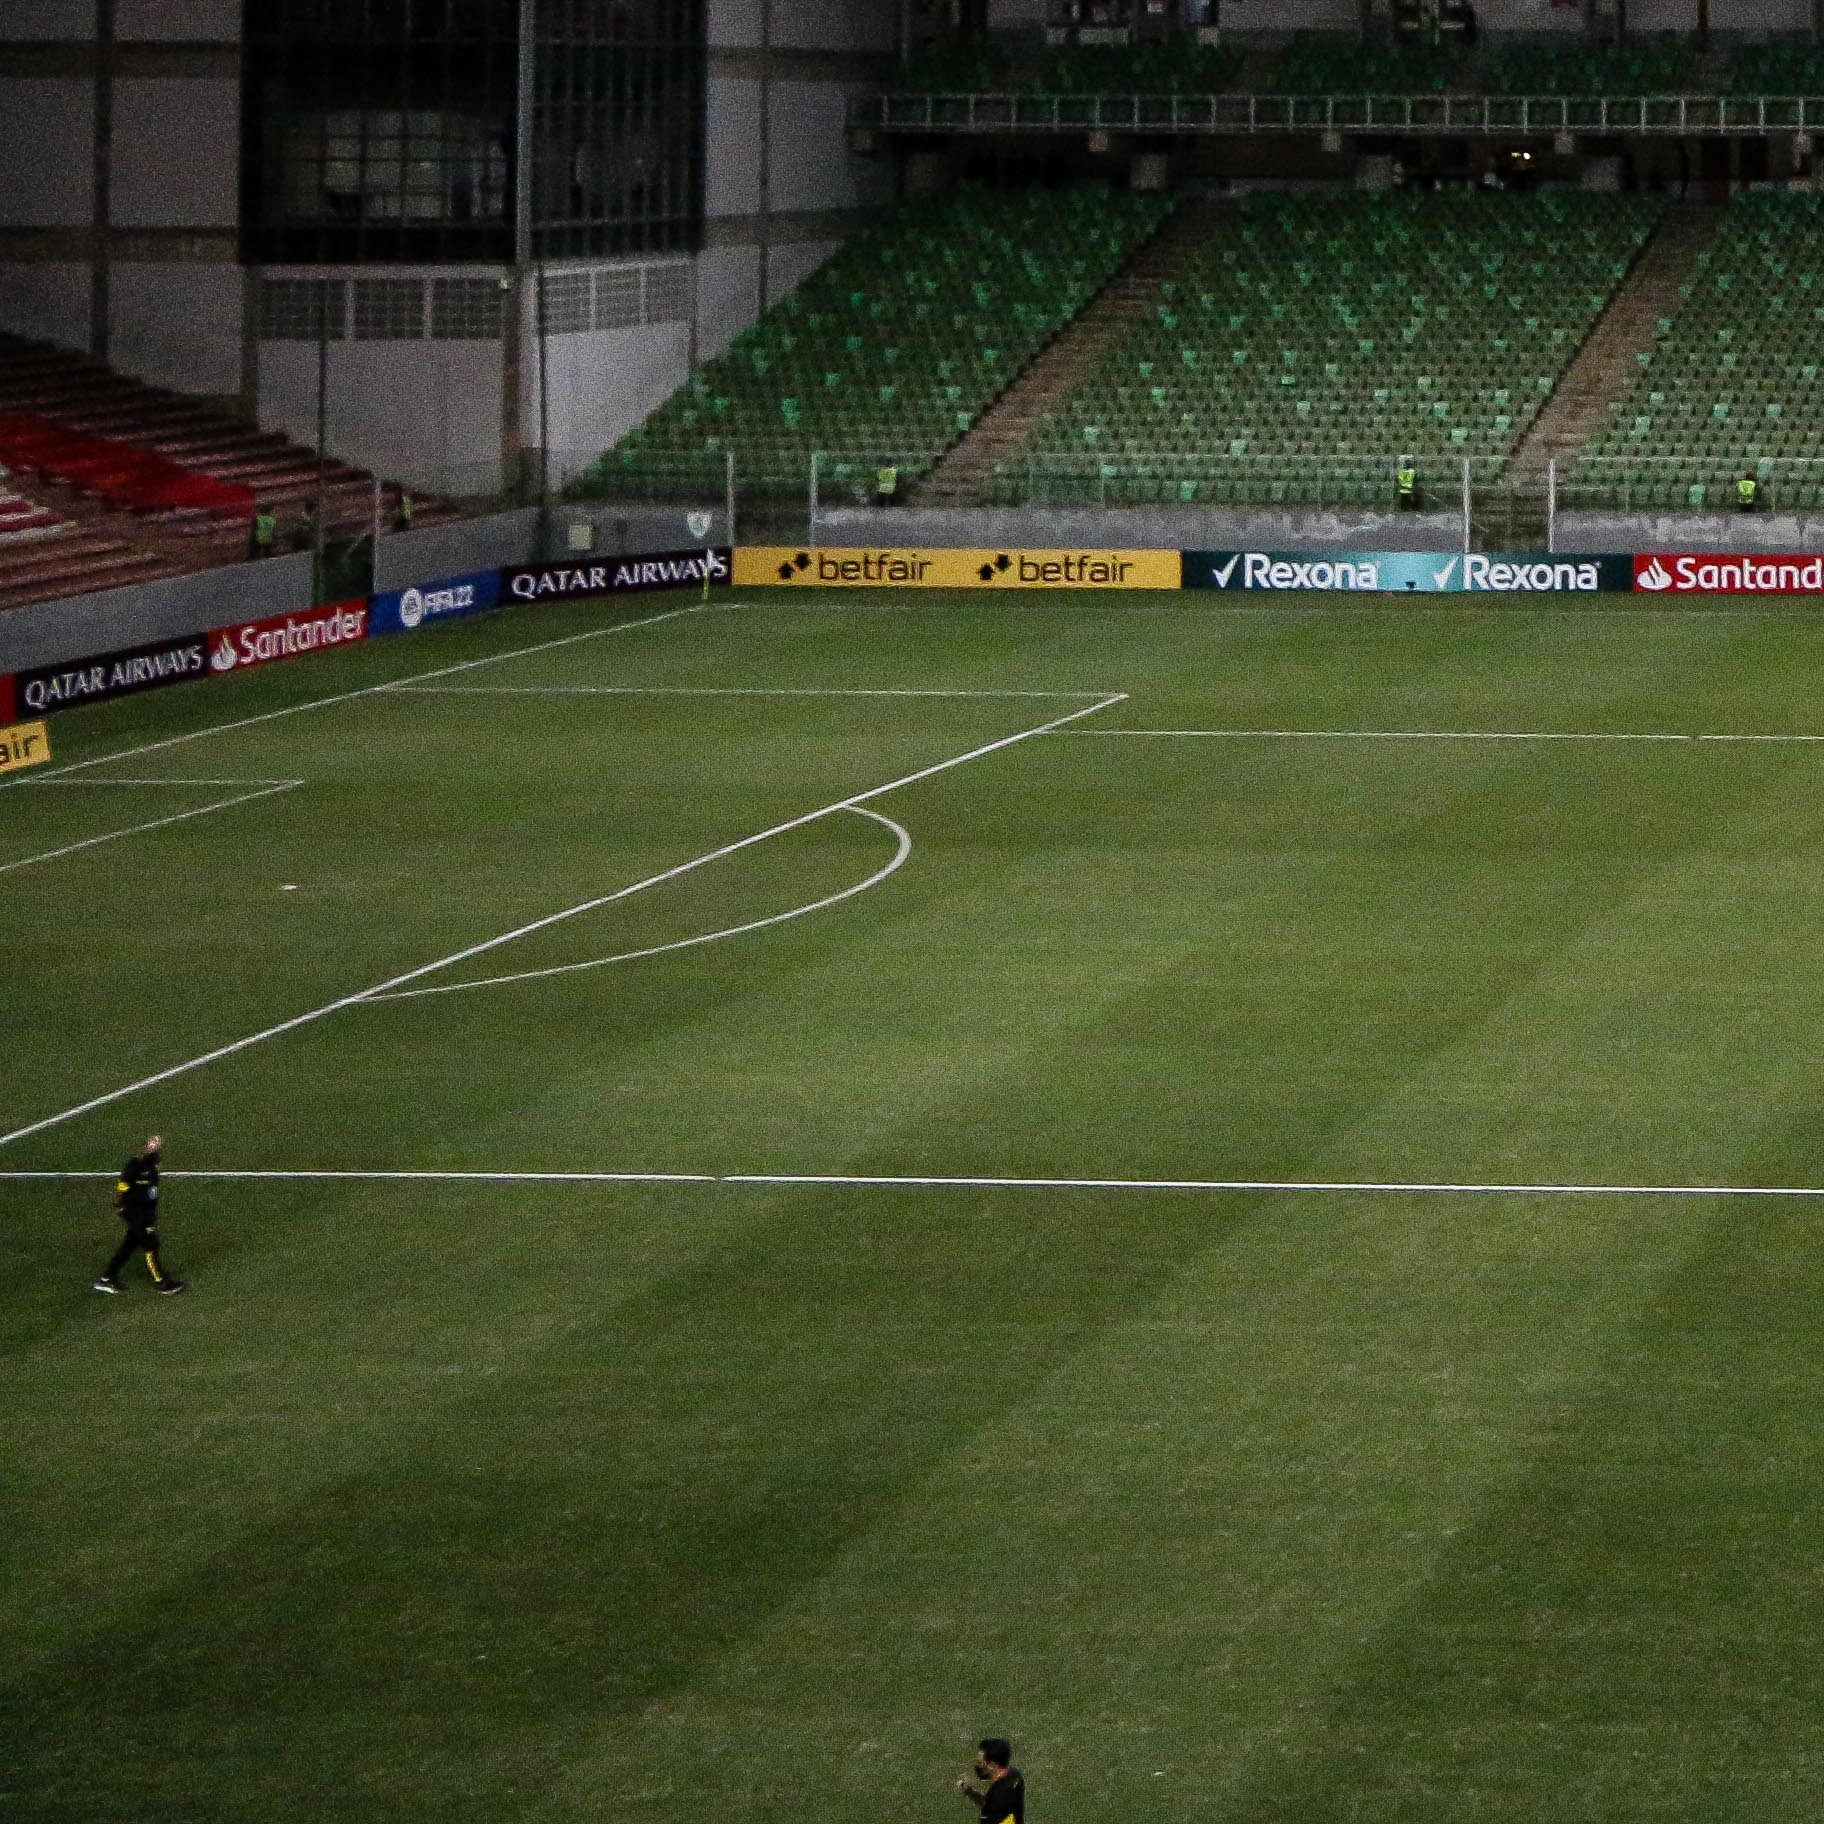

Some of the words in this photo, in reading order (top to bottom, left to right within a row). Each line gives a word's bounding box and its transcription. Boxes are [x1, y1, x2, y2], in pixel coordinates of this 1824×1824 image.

[512, 567, 606, 599] QATAR
[818, 553, 932, 582] betfair
[1019, 555, 1133, 583] betfair
[1245, 554, 1378, 590] Rexona
[1464, 558, 1598, 590] Rexona
[240, 606, 366, 664] Santander
[25, 667, 105, 709] QATAR
[110, 645, 203, 687] AIRWAYS
